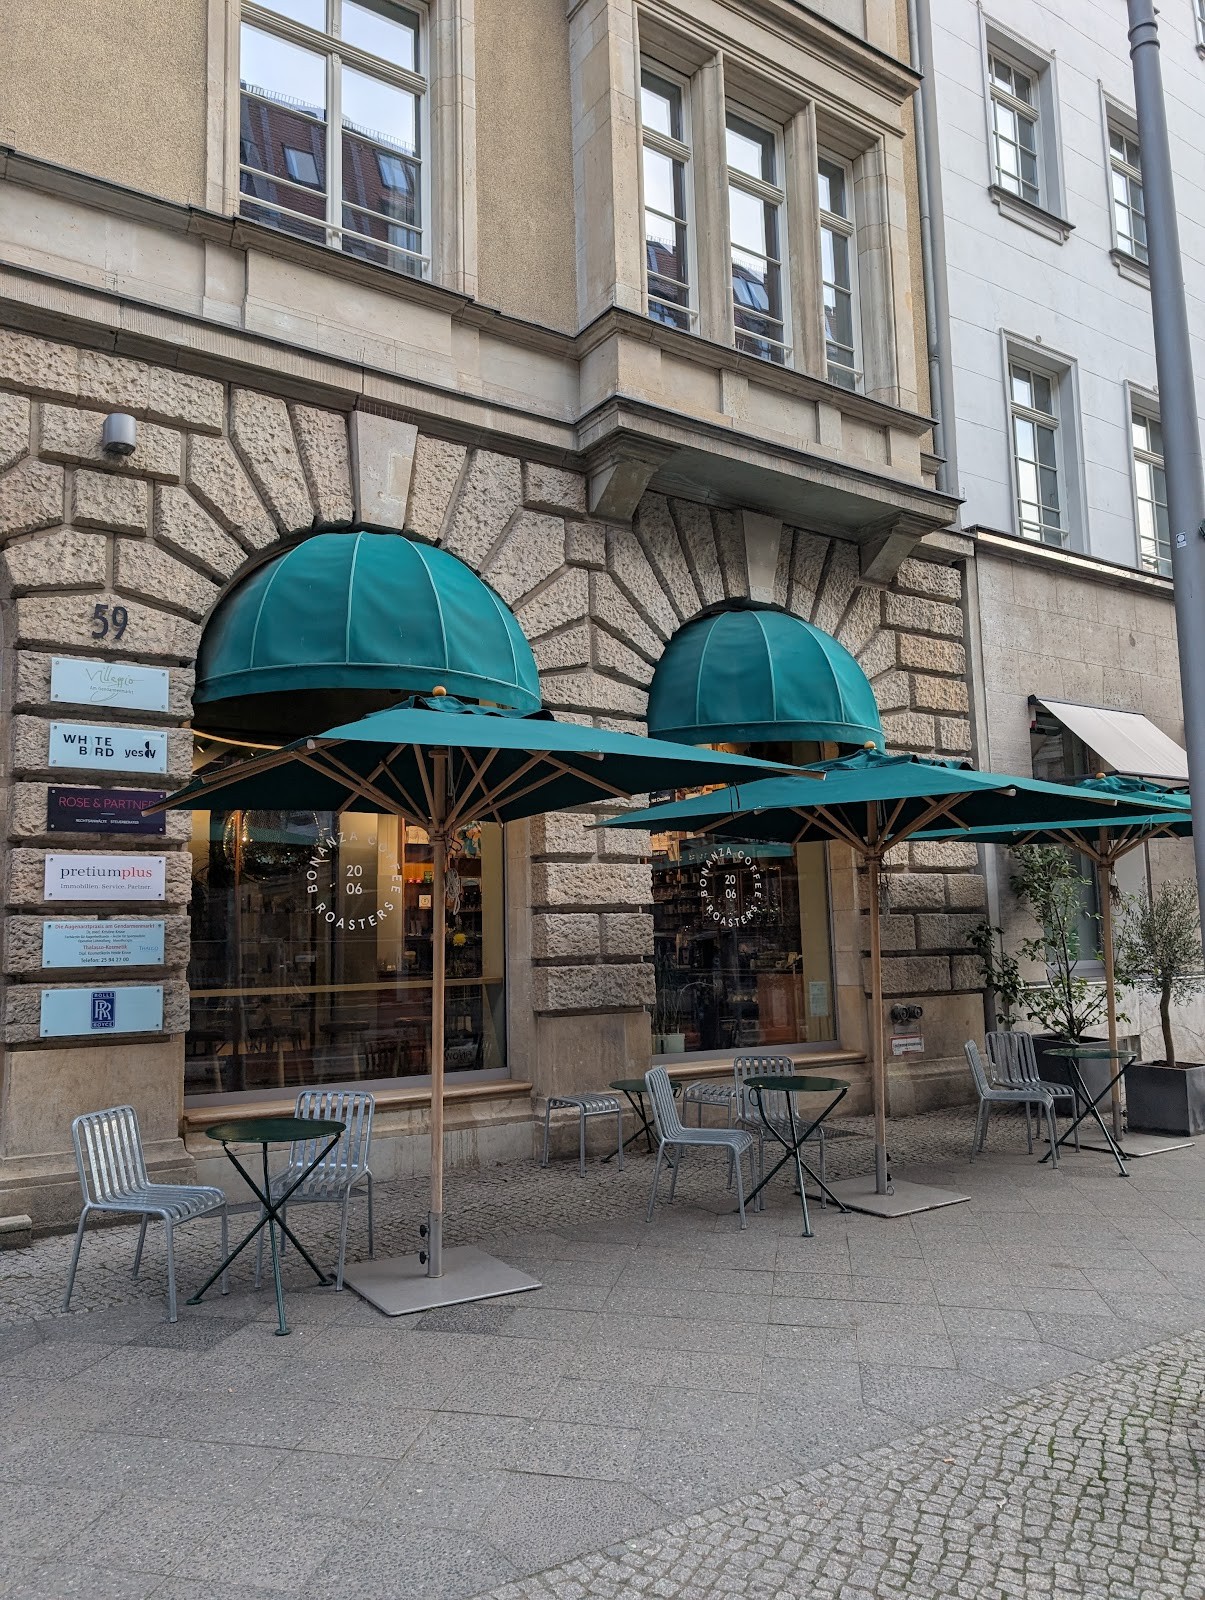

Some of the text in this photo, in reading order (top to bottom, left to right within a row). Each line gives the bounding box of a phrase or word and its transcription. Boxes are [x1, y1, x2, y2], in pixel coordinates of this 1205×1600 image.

[92, 603, 128, 639] 59
[59, 796, 91, 808] ROSE
[93, 797, 101, 808] &
[306, 832, 358, 894] BONANZA
[60, 866, 152, 879] pretiumplus
[346, 865, 363, 877] 20
[725, 875, 736, 885] 20
[346, 883, 363, 895] 06
[700, 847, 762, 927] BONANZA COFFEE ROASTERS
[725, 889, 737, 899] 06
[315, 902, 394, 930] ROASTERS
[95, 1000, 111, 1020] RR
